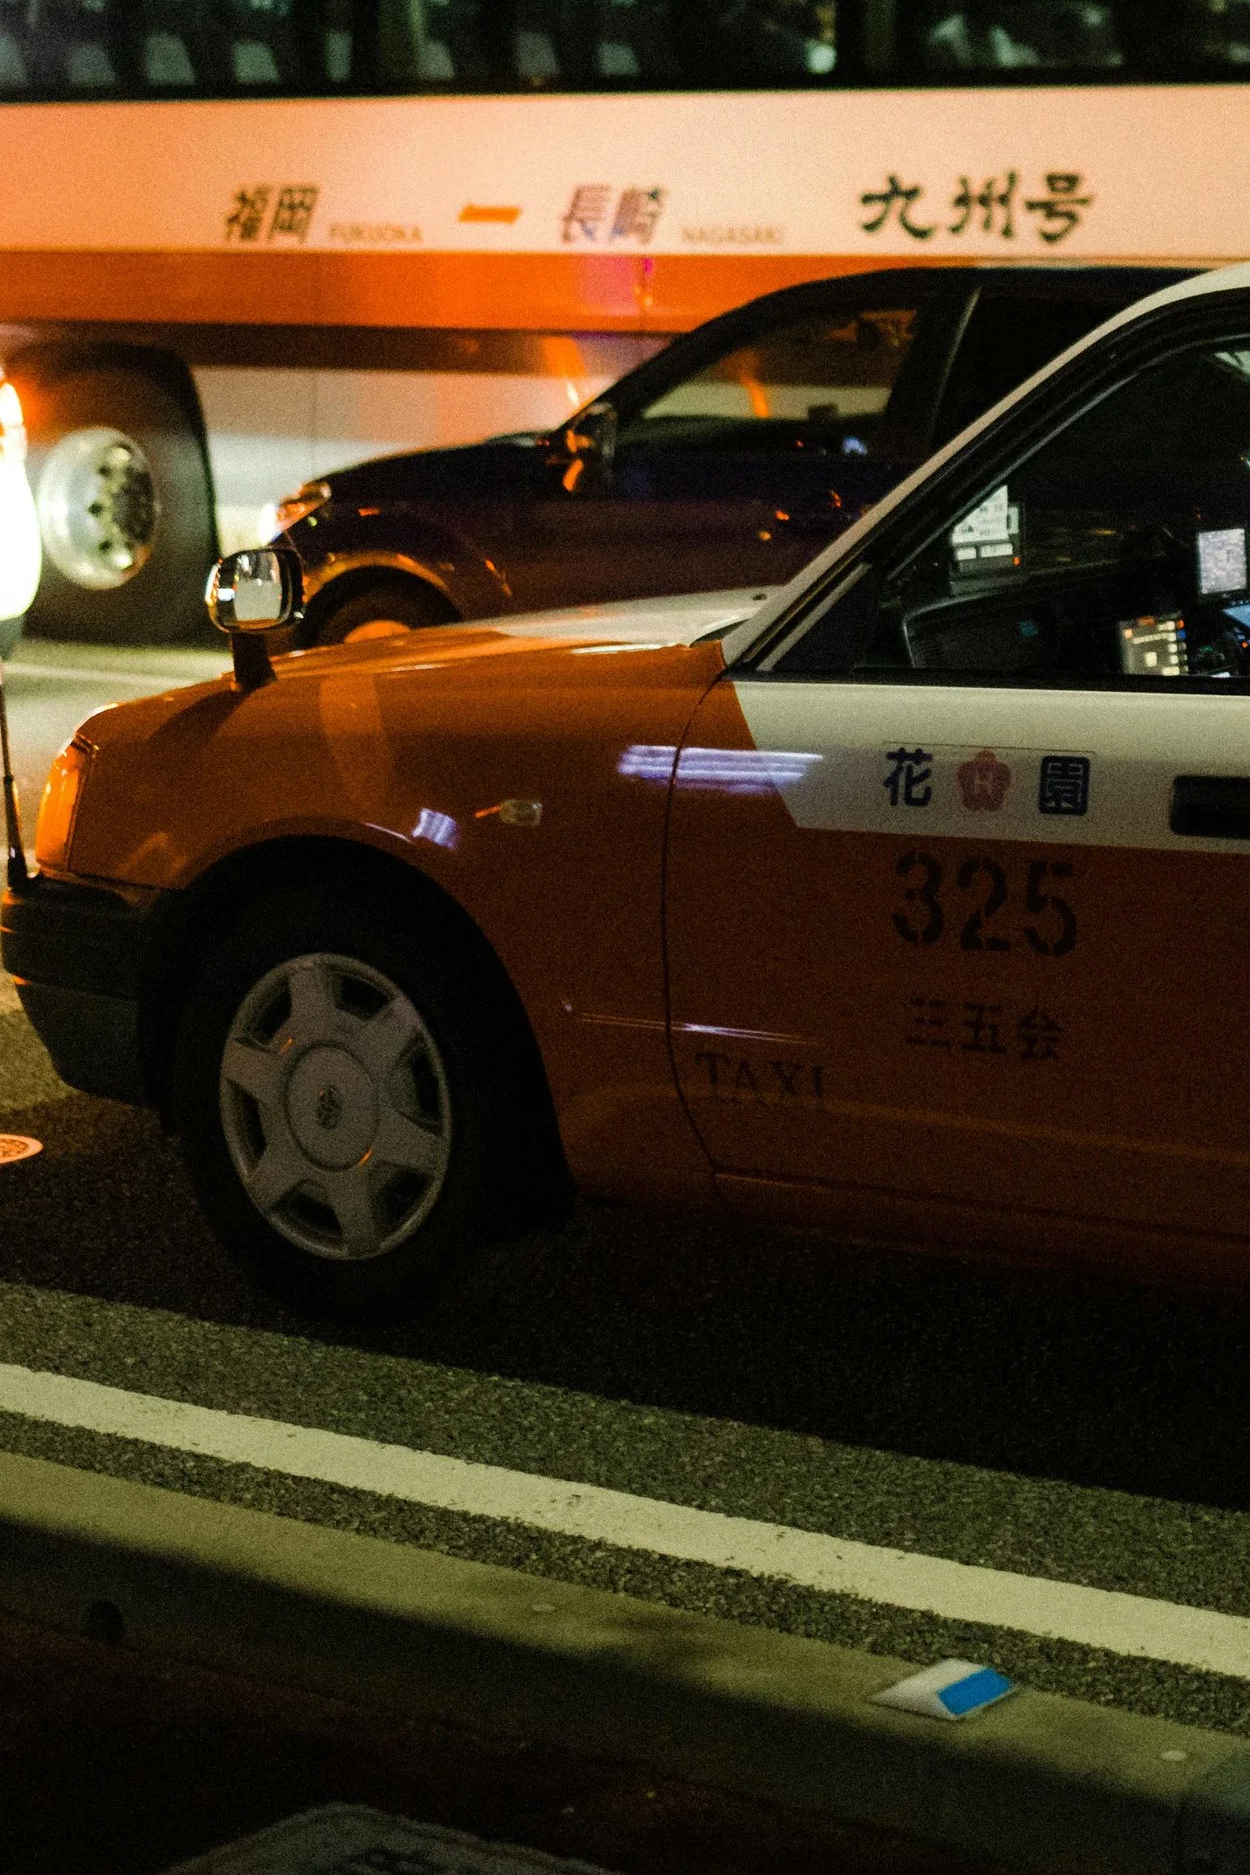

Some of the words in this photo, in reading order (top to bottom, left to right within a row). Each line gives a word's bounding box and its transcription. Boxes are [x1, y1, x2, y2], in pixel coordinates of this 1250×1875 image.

[225, 184, 320, 244] 福岡
[558, 183, 669, 245] 長崎
[858, 172, 1094, 244] 九州号
[884, 747, 933, 808] 花
[1038, 755, 1090, 816] 園
[892, 850, 1078, 956] 325
[906, 997, 1065, 1060] 三五会
[696, 1051, 826, 1112] TAXI
